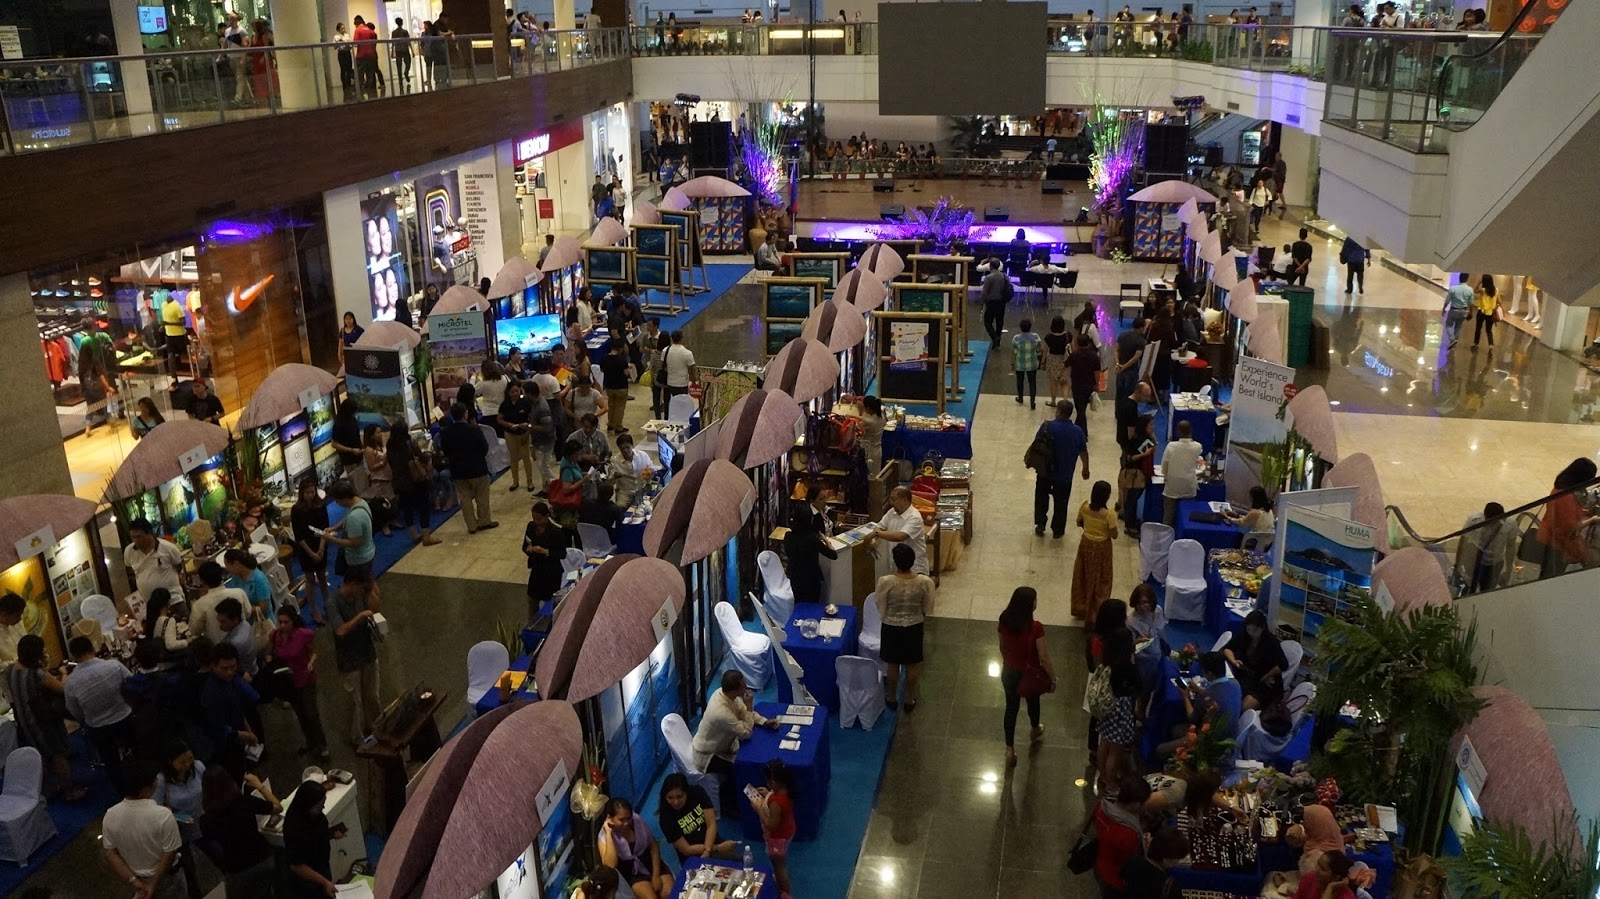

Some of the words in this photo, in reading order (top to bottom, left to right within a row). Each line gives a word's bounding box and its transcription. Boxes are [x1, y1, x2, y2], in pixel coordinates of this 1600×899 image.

[438, 320, 472, 328] MICROTEL
[1241, 361, 1288, 383] Experience
[1240, 372, 1274, 392] World's
[1238, 384, 1255, 397] Best
[1257, 390, 1283, 405] Island
[1345, 524, 1370, 539] HUMA
[677, 811, 696, 829] SHUT
